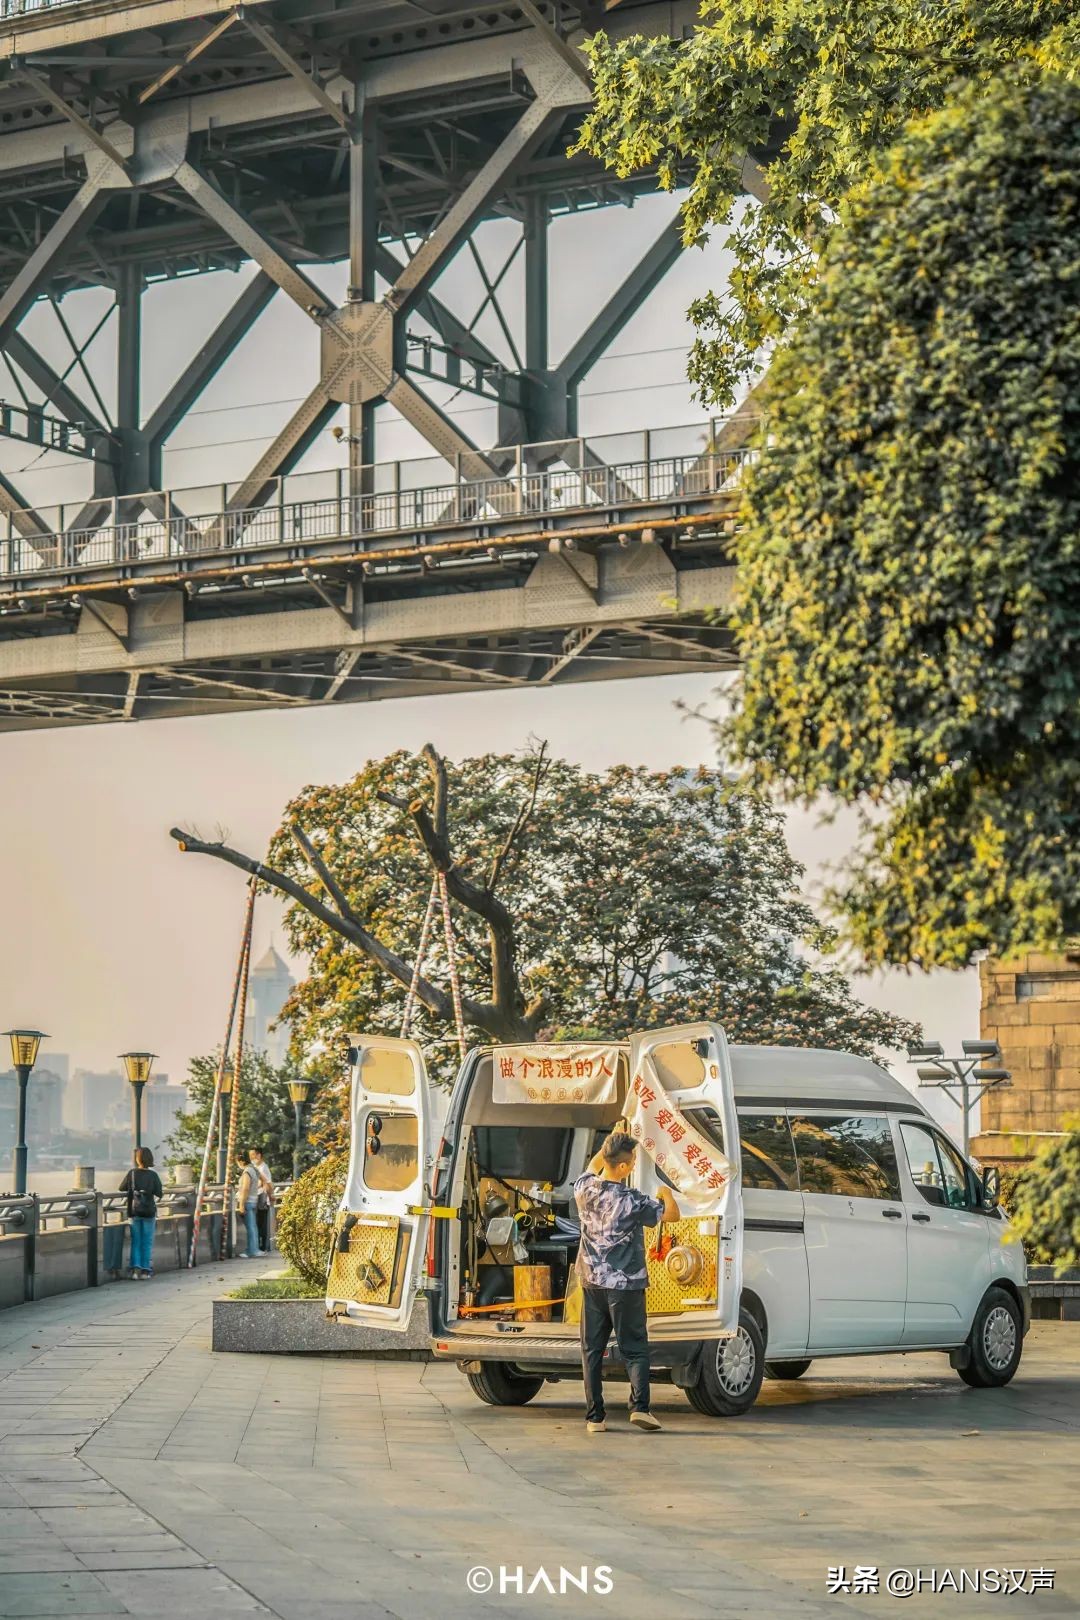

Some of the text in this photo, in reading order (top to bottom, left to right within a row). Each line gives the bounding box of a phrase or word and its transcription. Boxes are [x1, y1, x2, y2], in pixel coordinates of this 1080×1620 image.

[500, 1057, 613, 1079] 做个浪漫的人
[654, 1108, 686, 1143] 爱喝
[682, 1143, 726, 1189] 爱练琴
